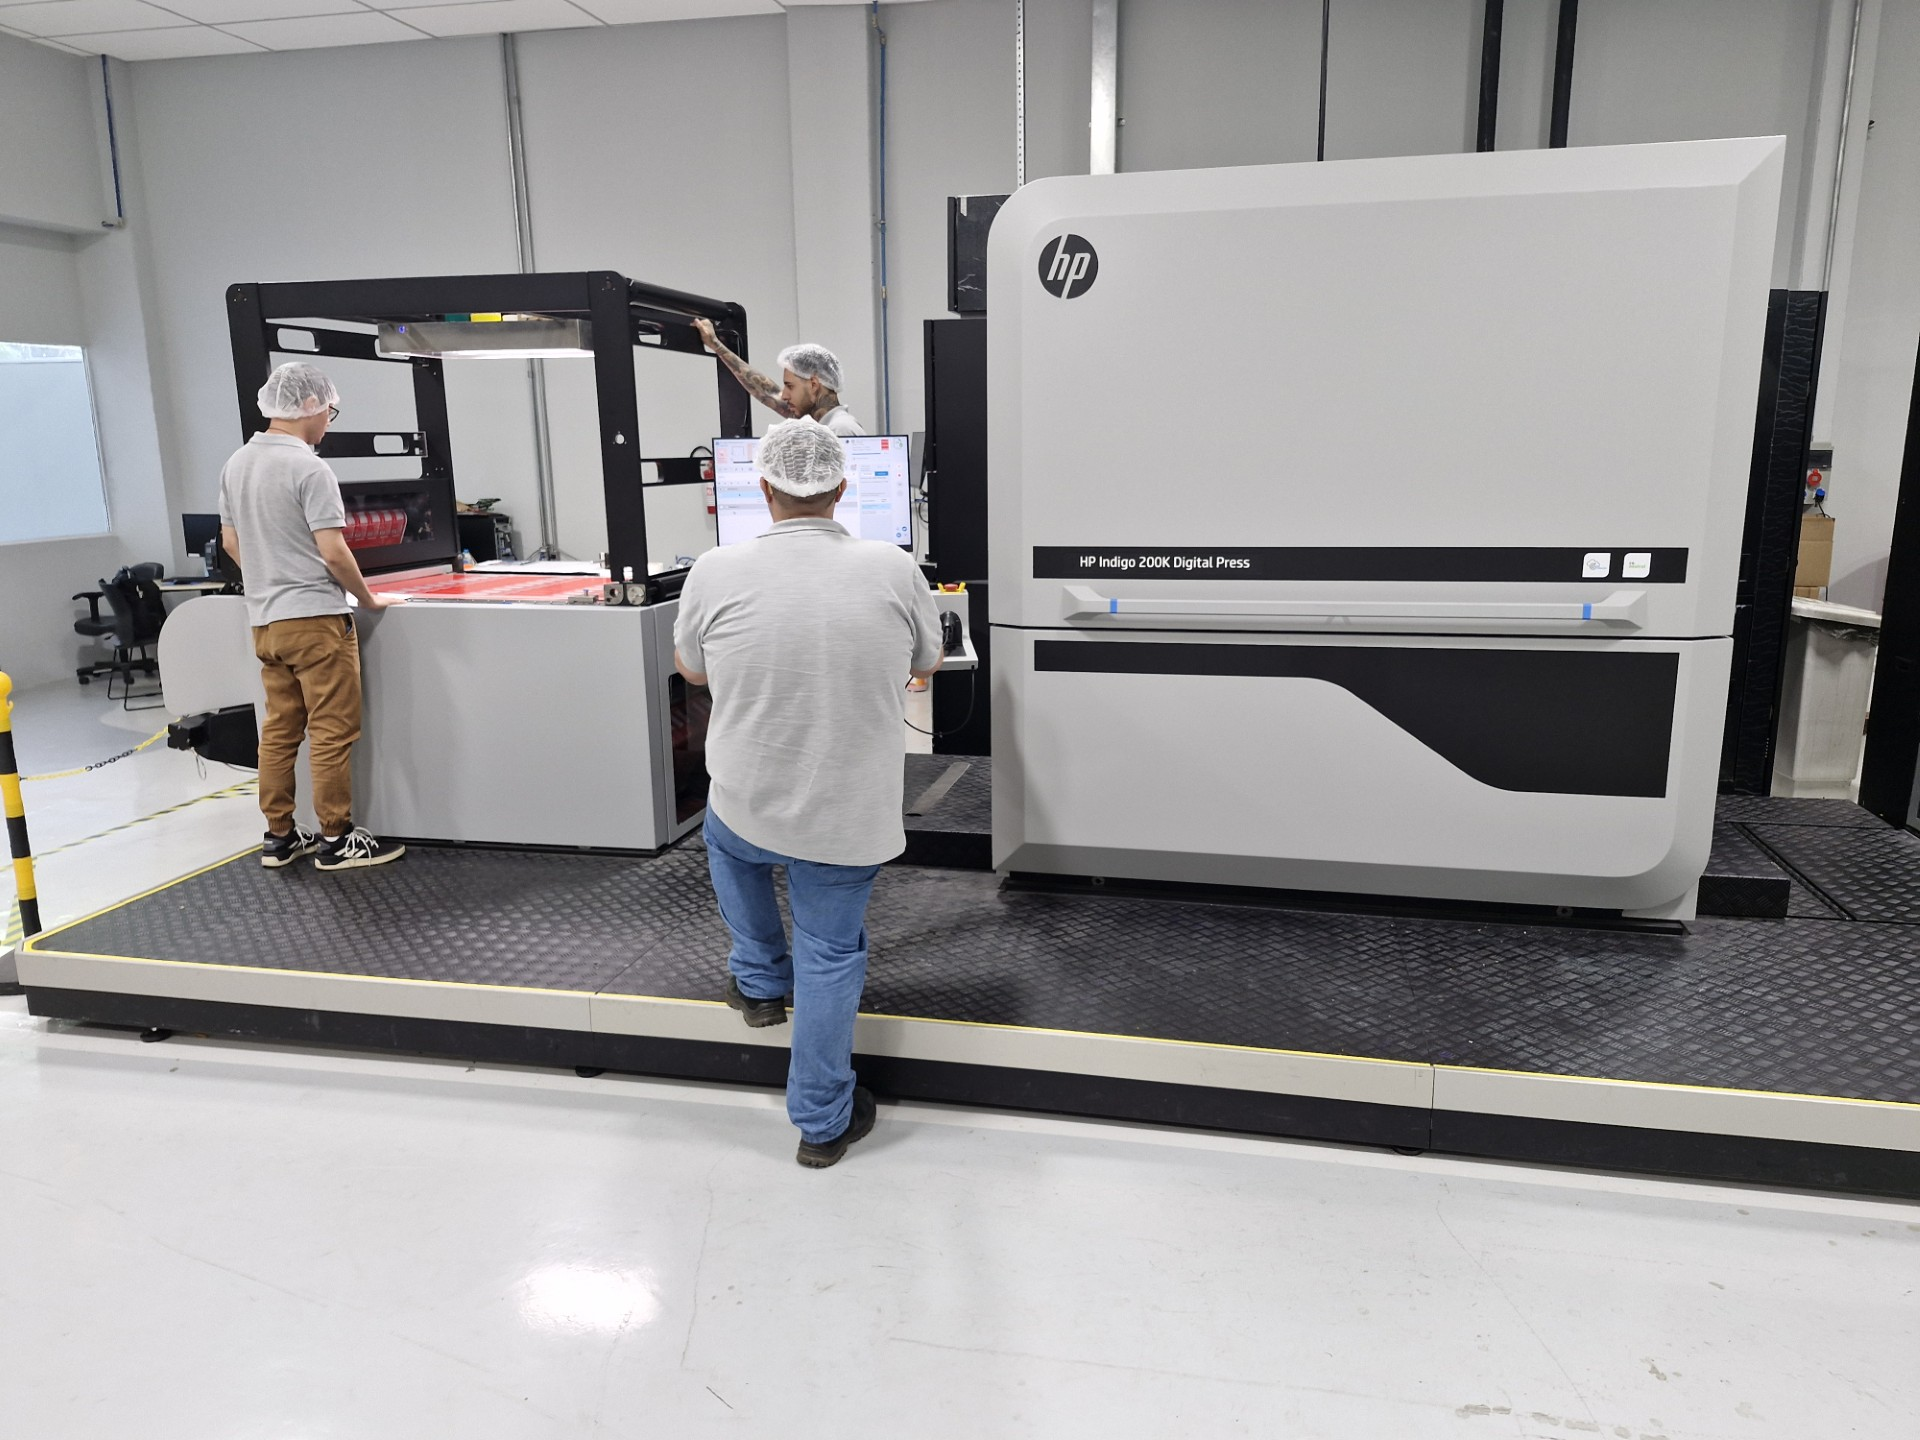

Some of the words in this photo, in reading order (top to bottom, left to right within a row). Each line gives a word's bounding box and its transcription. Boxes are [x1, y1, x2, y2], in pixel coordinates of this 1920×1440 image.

[1045, 234, 1093, 299] hp
[1079, 556, 1096, 568] HP
[1099, 556, 1136, 571] Indigo
[1138, 556, 1171, 568] 200K
[1173, 556, 1213, 571] Digital
[1216, 556, 1251, 569] Press
